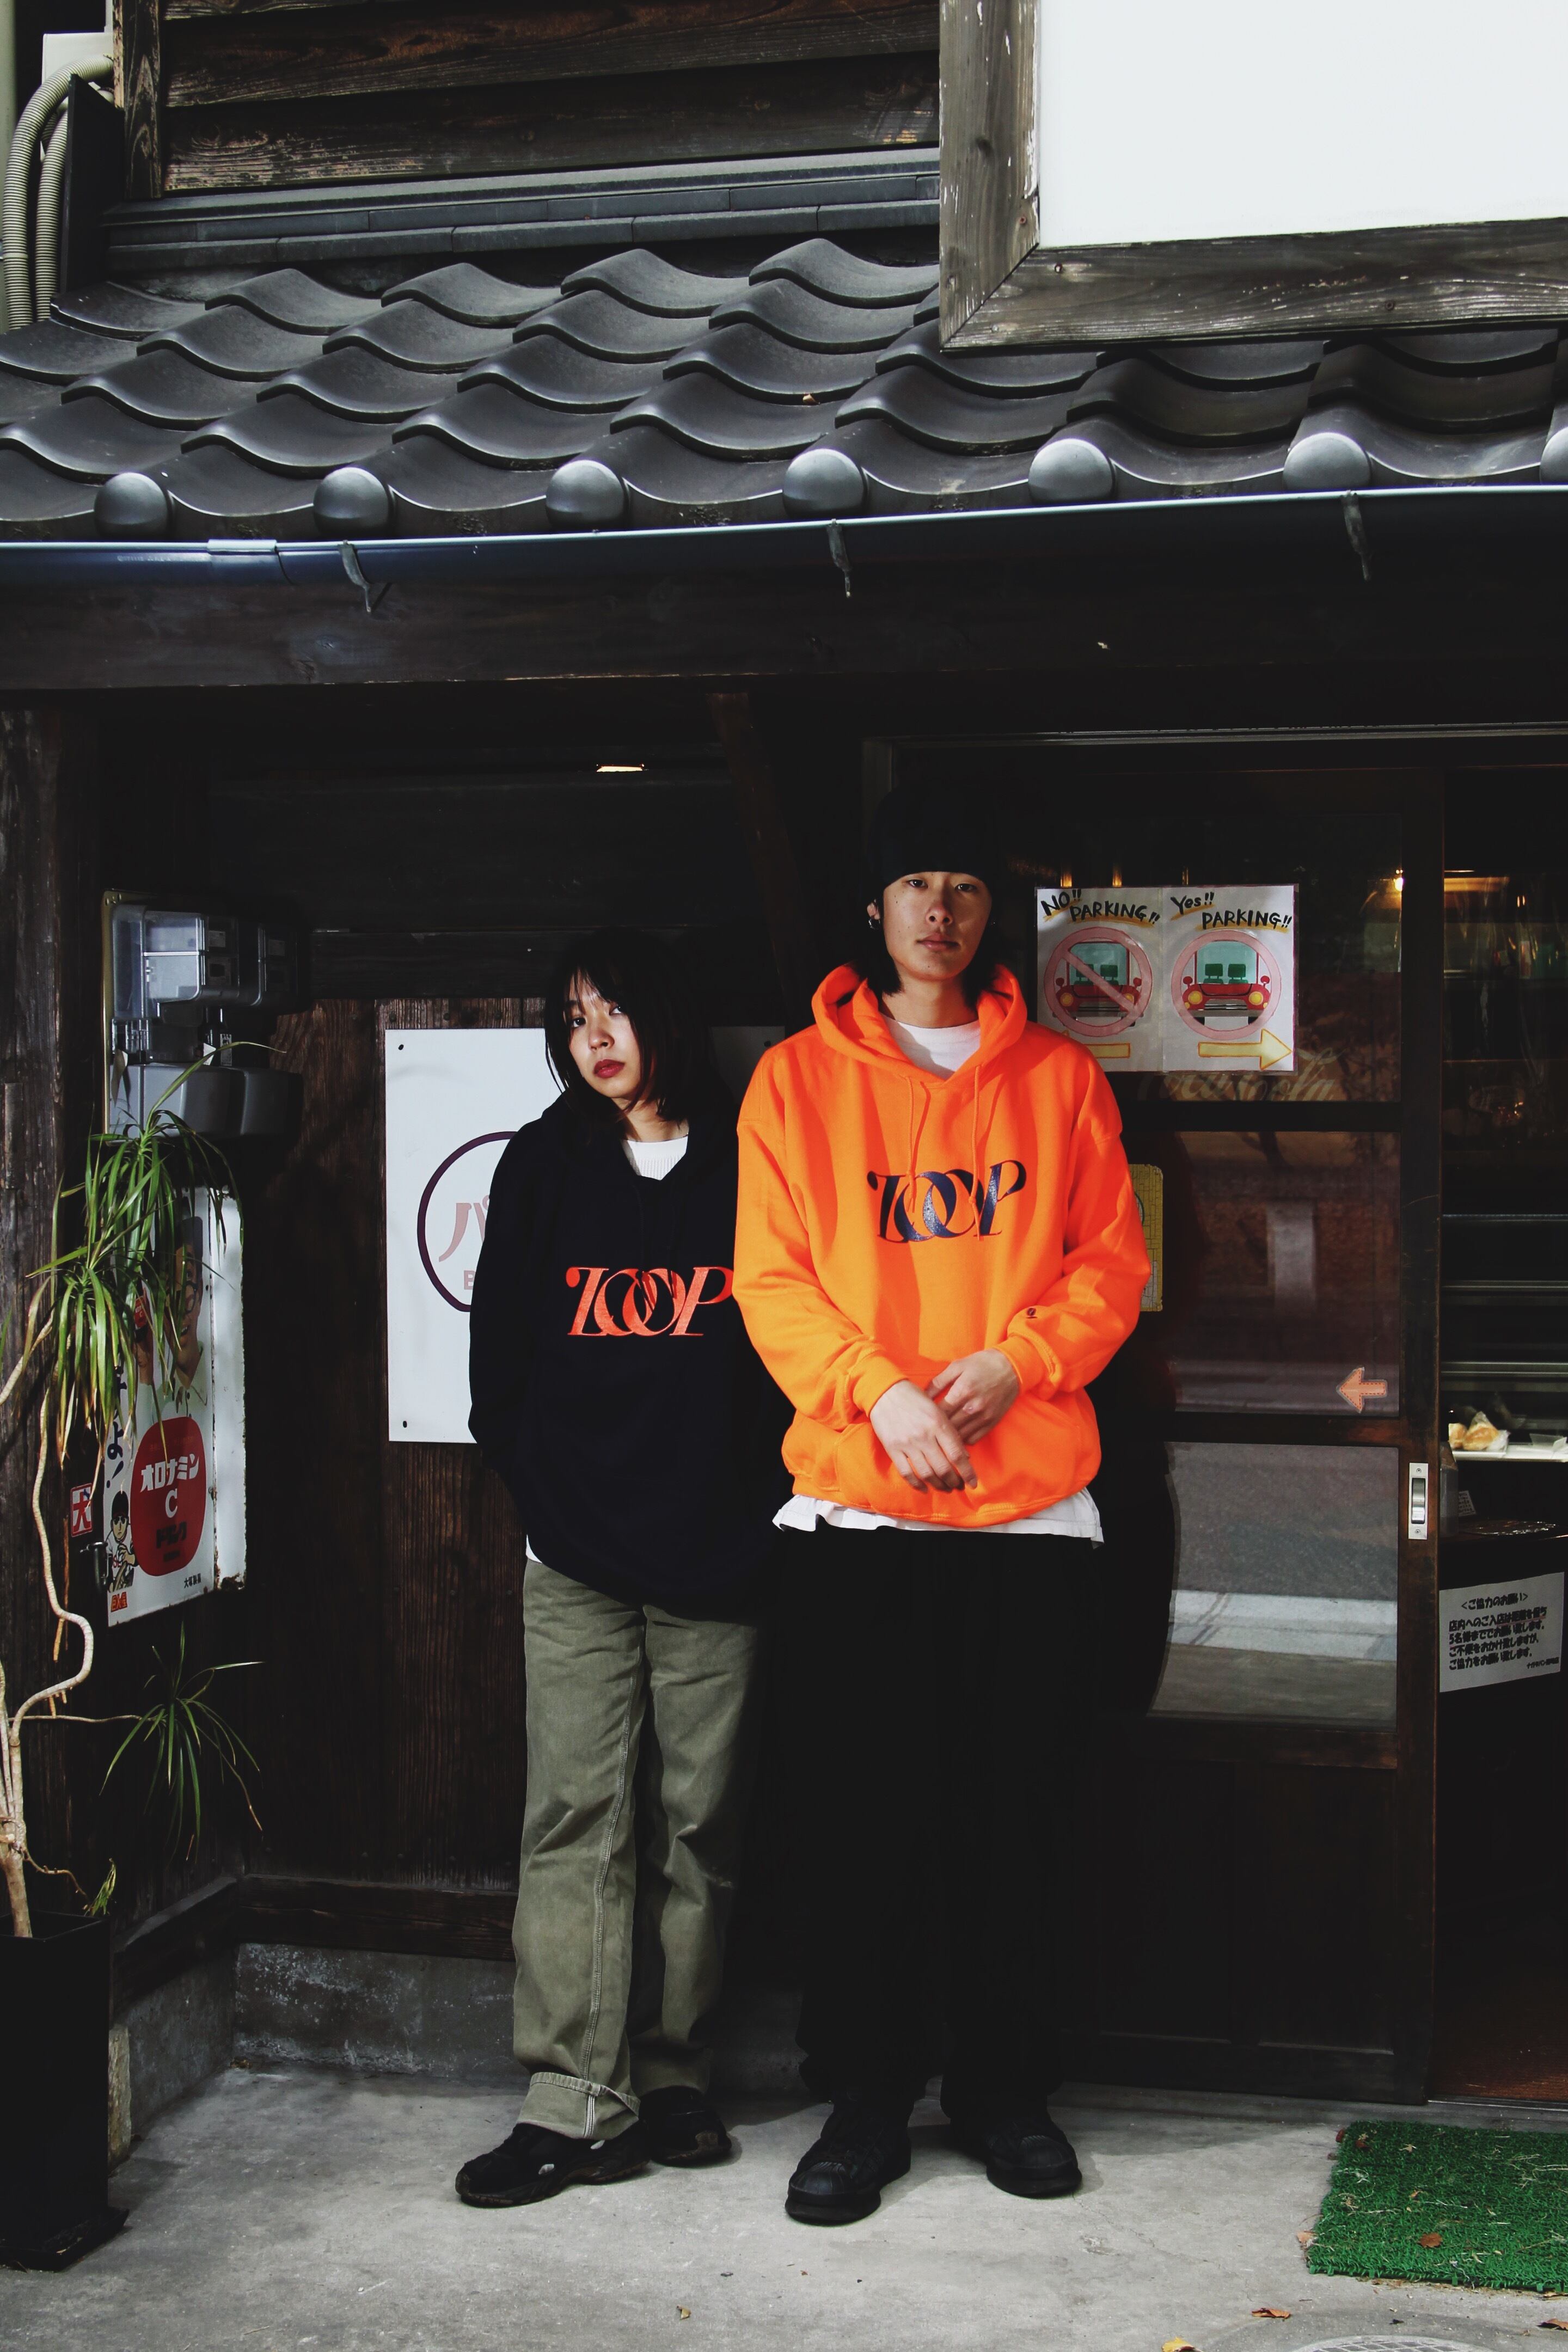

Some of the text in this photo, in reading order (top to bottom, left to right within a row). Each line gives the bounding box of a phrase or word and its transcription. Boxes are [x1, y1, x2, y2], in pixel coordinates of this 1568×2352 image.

[1041, 890, 1160, 924] NO!! PARKING!!
[1171, 892, 1293, 929] Yes!! PARKING!!
[140, 1454, 199, 1492] オロナミン
[166, 1488, 177, 1518] C
